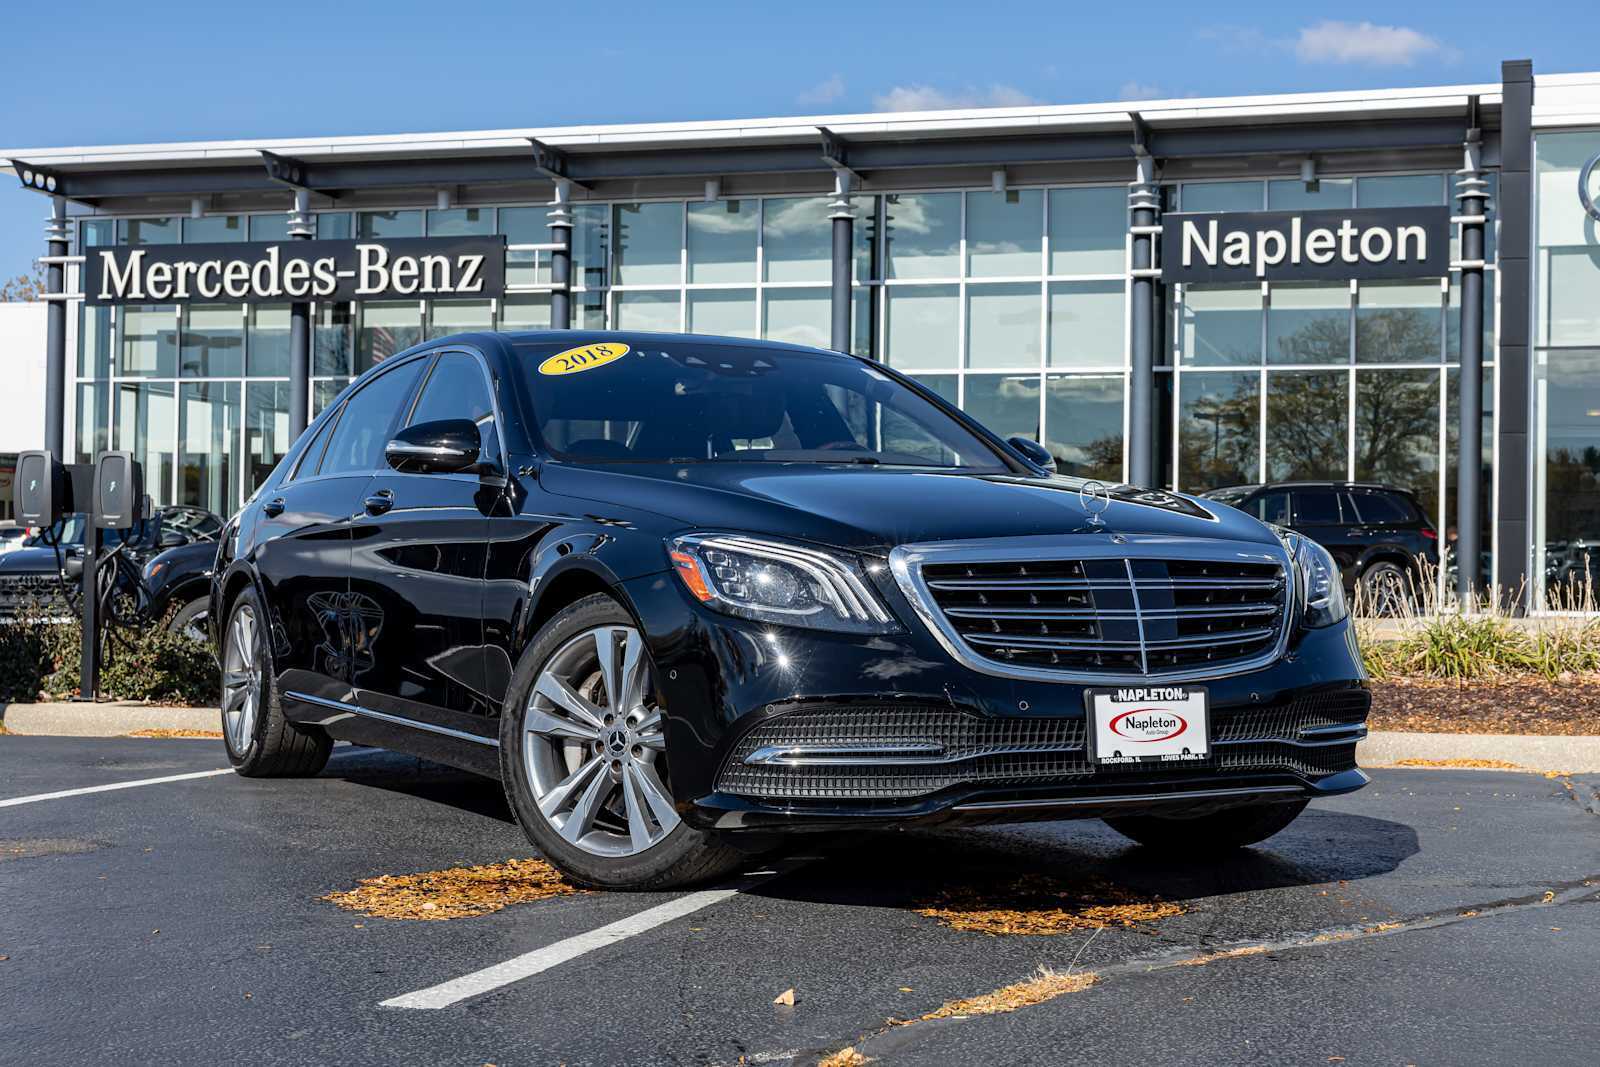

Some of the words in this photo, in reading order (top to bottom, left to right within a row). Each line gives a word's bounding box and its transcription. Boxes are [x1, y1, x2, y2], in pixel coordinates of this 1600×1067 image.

[1182, 217, 1427, 276] Napleton
[98, 244, 485, 299] Mercedes-Benz
[556, 345, 613, 371] 2018
[1118, 687, 1183, 702] NAPLETON
[1126, 715, 1176, 731] Napleton
